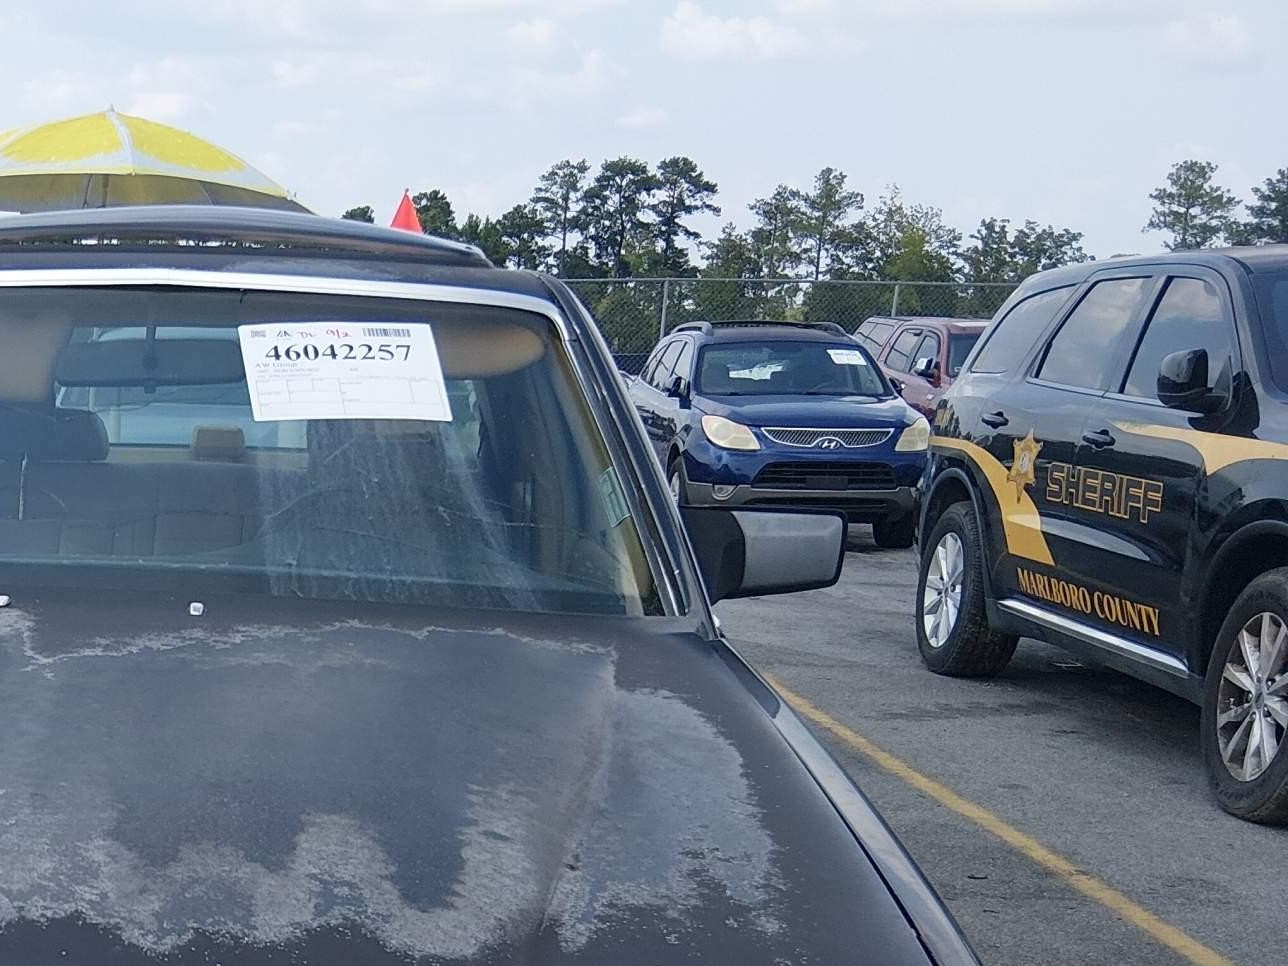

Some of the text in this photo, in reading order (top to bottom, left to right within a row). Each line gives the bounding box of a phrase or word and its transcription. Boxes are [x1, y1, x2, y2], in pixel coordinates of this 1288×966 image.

[264, 343, 412, 362] 46042257
[1045, 462, 1164, 524] SHERIFF
[1016, 567, 1161, 636] MARLBORO COUNTY
